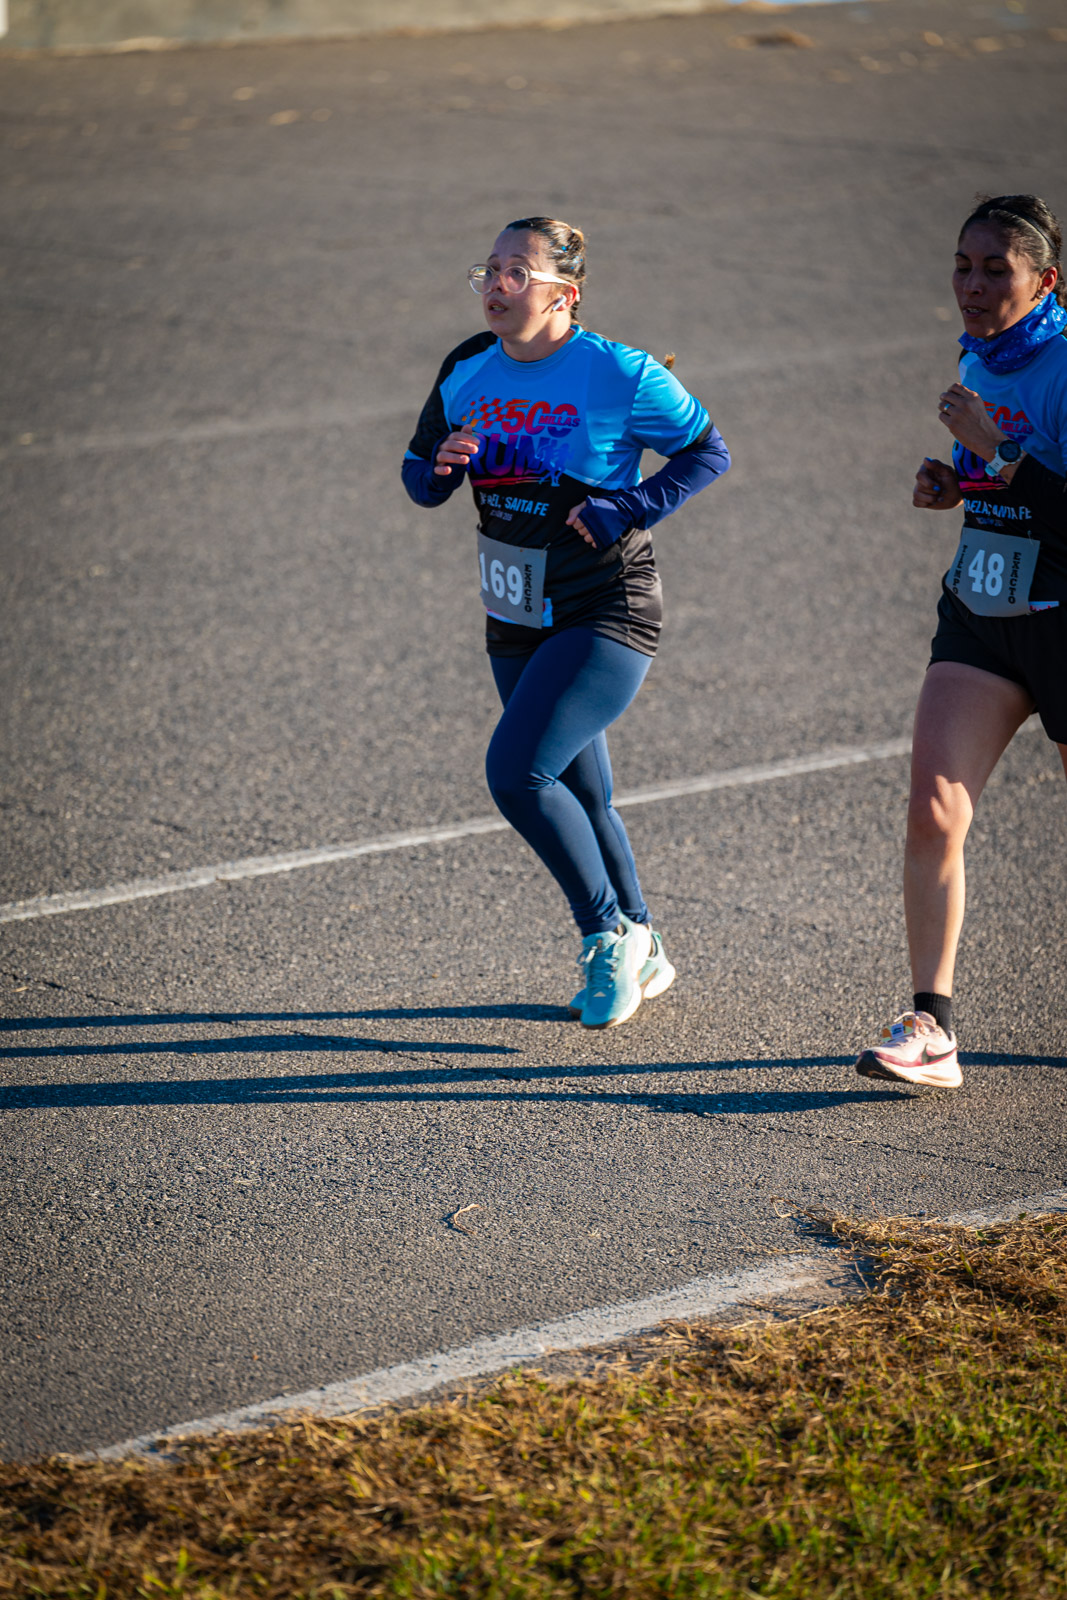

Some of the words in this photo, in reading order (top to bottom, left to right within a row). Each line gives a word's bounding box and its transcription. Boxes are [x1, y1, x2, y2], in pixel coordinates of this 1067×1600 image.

[501, 399, 578, 438] 500
[538, 413, 581, 428] MILLAS
[1000, 421, 1034, 435] MILLAS
[533, 502, 549, 516] FE
[1018, 505, 1033, 521] FE
[479, 552, 523, 605] 169
[524, 563, 533, 613] EXACTO
[952, 544, 968, 595] TIEMPO
[967, 548, 1005, 597] 48
[1007, 551, 1022, 605] EXACTO
